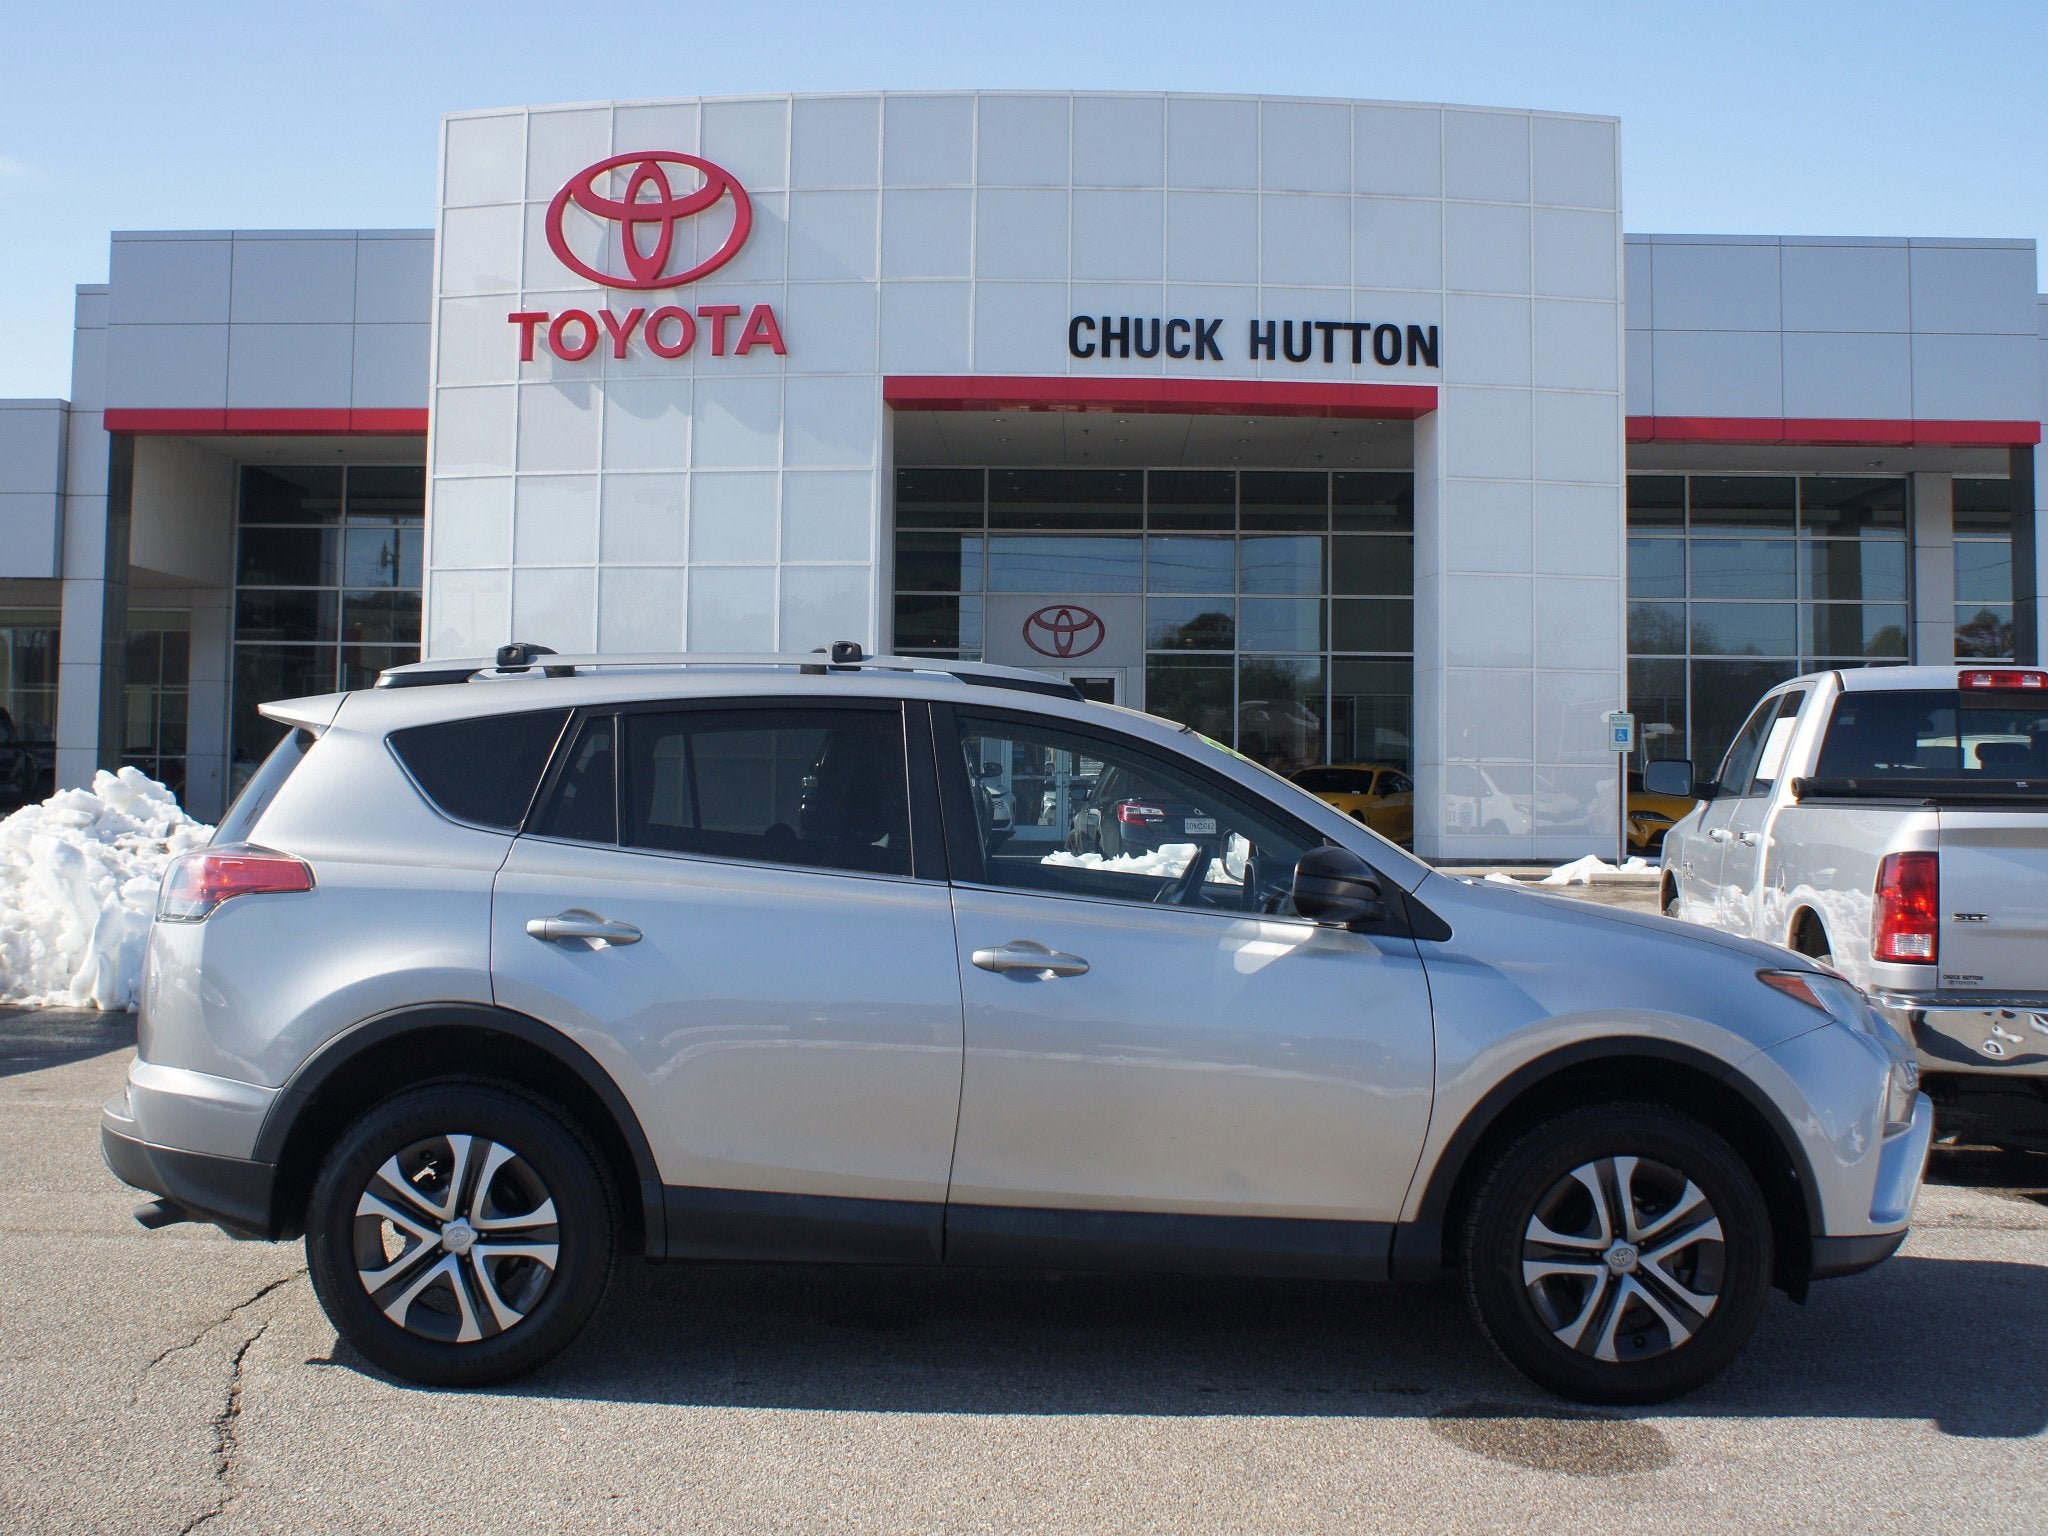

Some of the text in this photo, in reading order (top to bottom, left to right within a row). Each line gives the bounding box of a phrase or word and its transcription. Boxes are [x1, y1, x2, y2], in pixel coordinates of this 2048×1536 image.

[508, 304, 788, 362] TOYOTA
[1069, 315, 1439, 368] CHUCK HUTTON
[1952, 912, 1988, 922] SLT
